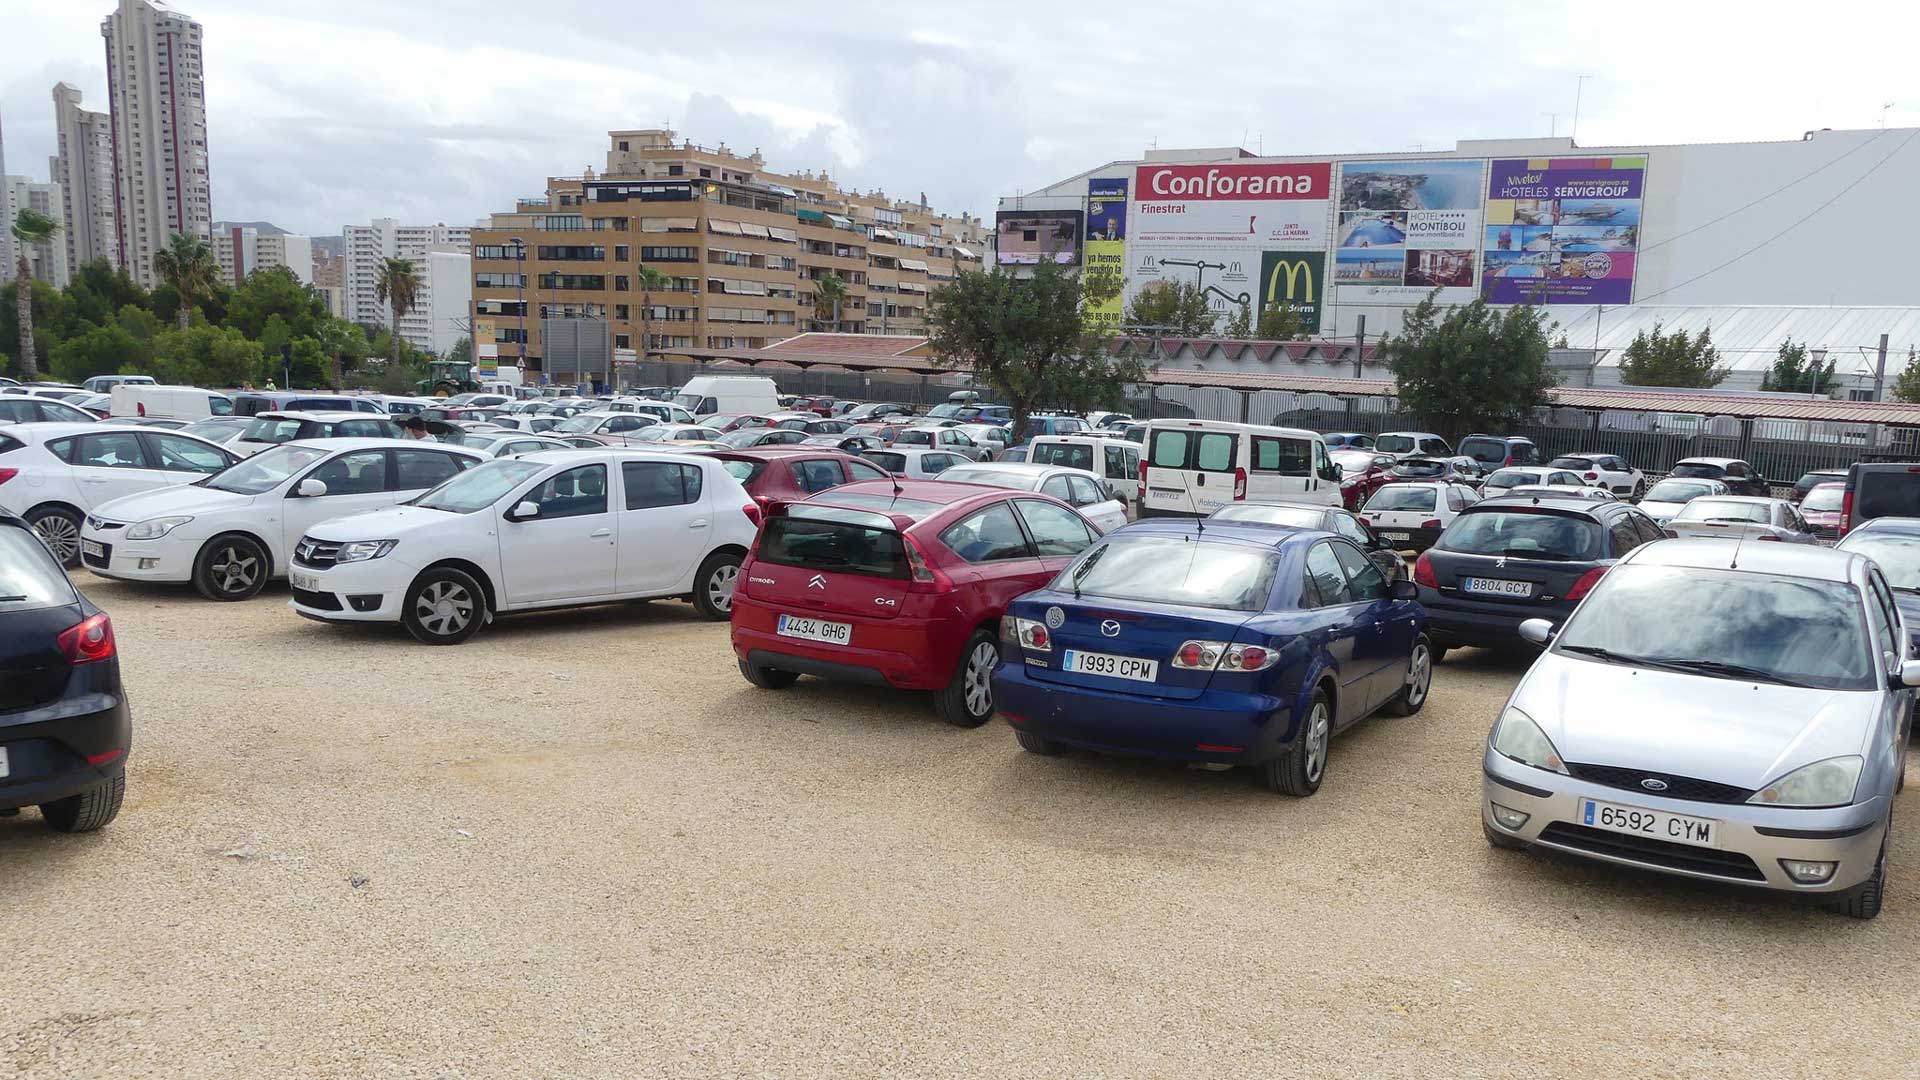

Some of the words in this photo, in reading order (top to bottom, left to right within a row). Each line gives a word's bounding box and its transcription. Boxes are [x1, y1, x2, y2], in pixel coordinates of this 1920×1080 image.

[1152, 169, 1312, 197] Conforama
[1501, 187, 1549, 197] HOTELES
[1554, 186, 1629, 197] SERVIGROUP
[1141, 204, 1186, 214] Finestrat
[1410, 213, 1440, 221] HOTEL
[1088, 255, 1096, 264] ya
[1097, 253, 1121, 263] hemos
[1115, 264, 1122, 274] la
[1473, 579, 1501, 592] 8804
[1505, 582, 1529, 594] GCX
[874, 597, 895, 606] C4
[786, 619, 816, 637] 4434
[821, 623, 847, 639] GHG
[1078, 654, 1115, 674] 1993
[1120, 660, 1151, 680] CPM
[1601, 806, 1655, 833] 6592
[1667, 817, 1710, 843] CYM
